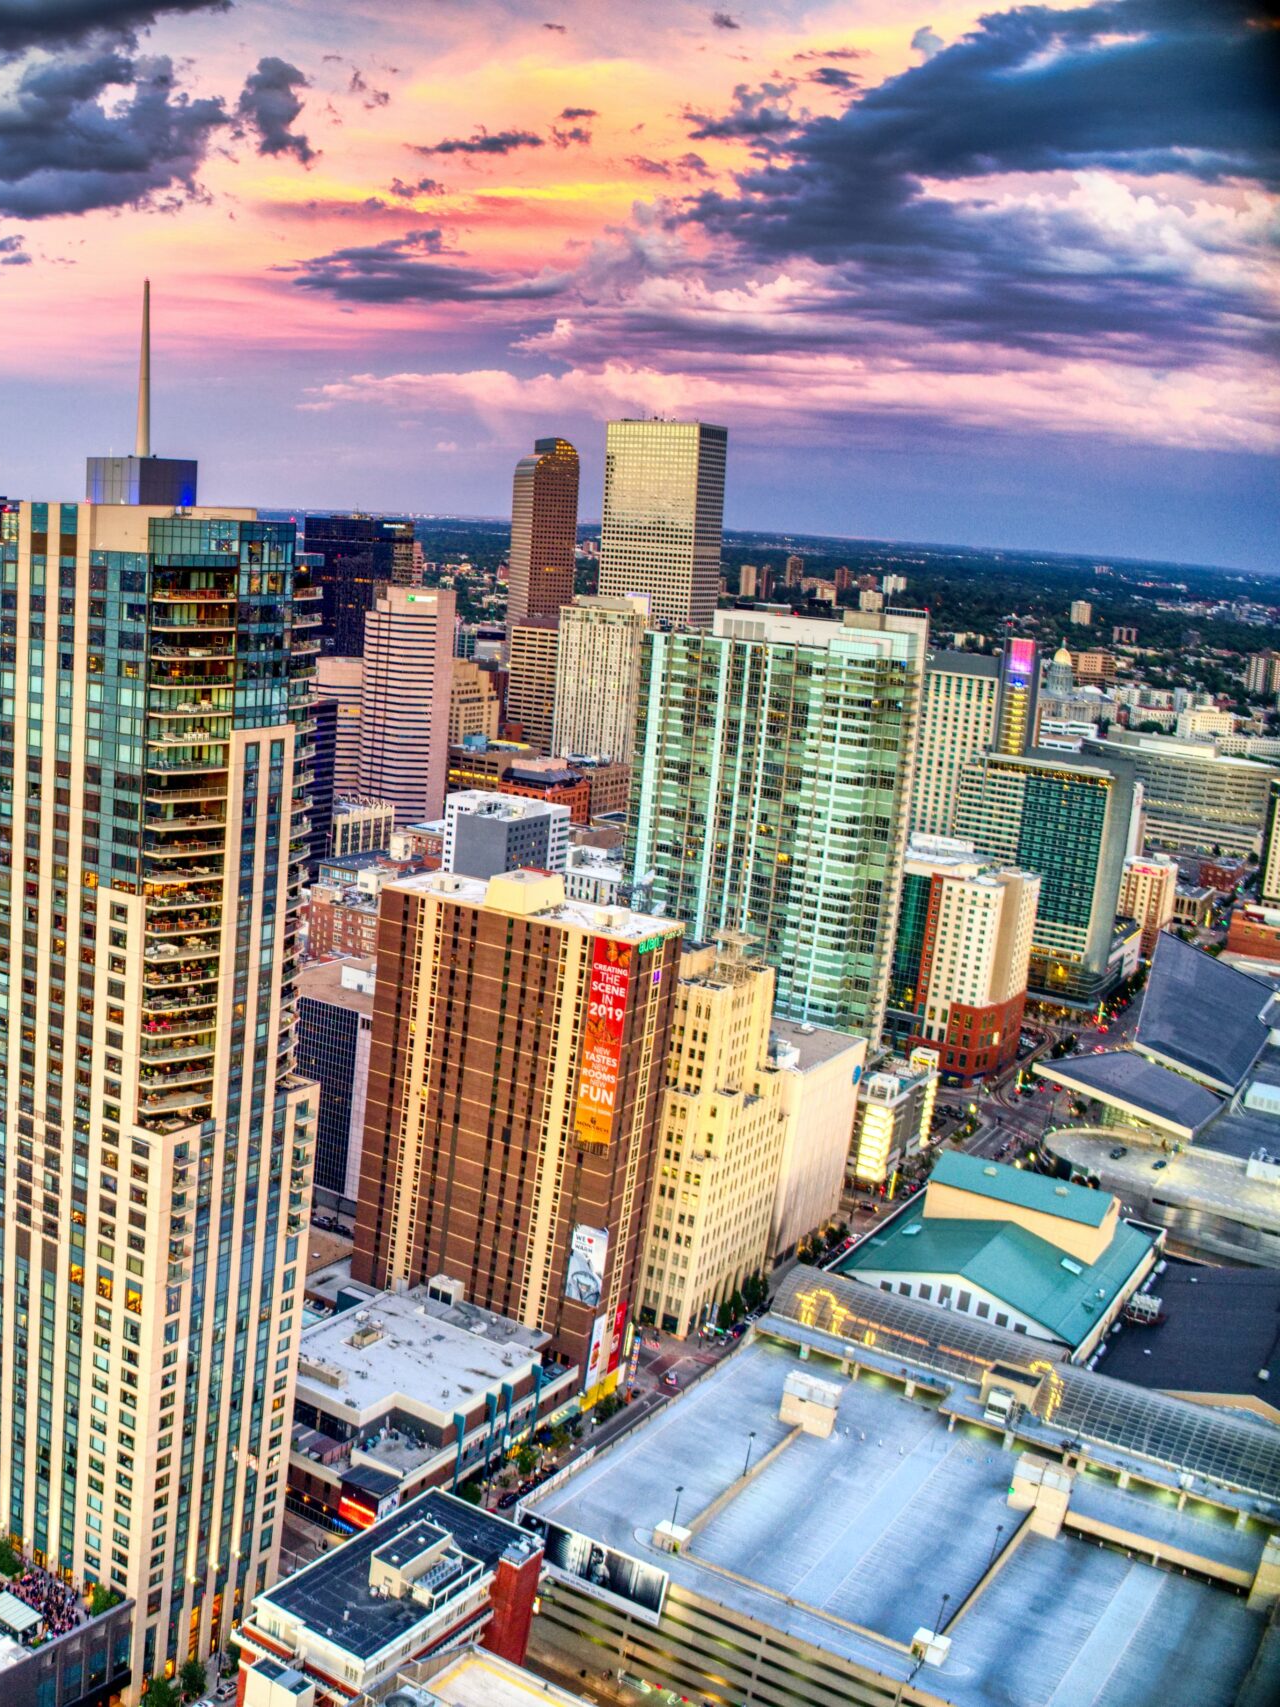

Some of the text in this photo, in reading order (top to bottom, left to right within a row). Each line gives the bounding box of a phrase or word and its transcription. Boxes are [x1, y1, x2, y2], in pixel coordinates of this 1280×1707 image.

[593, 963, 627, 976] CREATING
[600, 971, 621, 986] THE
[592, 980, 626, 998] SCENE
[601, 993, 614, 1006] IN
[589, 1001, 624, 1022] 2019
[585, 1050, 618, 1067] TASTES
[593, 1045, 611, 1057] NEW
[591, 1062, 609, 1073] NEW
[582, 1067, 616, 1084] ROOMS
[589, 1077, 607, 1088] NEW
[580, 1083, 614, 1106] FUN
